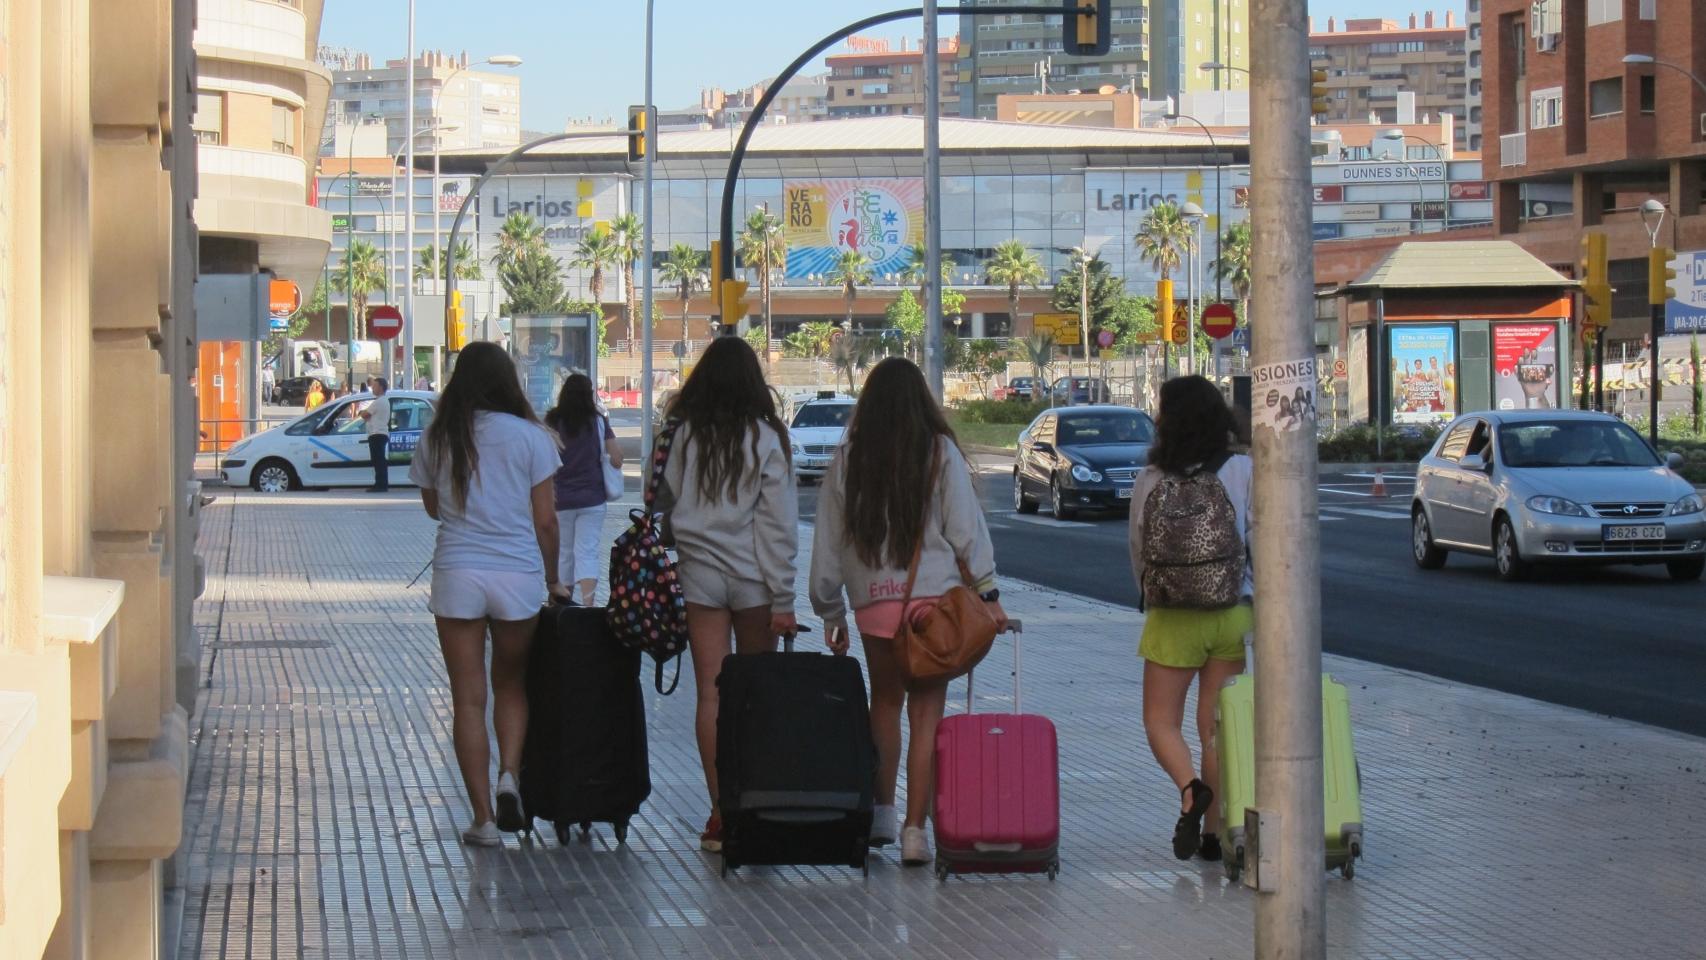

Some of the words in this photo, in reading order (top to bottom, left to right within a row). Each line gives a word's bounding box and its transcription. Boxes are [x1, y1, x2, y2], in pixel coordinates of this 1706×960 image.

[1343, 167, 1392, 179] DUNNES
[1395, 165, 1442, 178] STORES
[1096, 188, 1178, 211] Larios
[493, 195, 573, 218] Larios
[1674, 316, 1697, 329] MA-20
[1175, 330, 1187, 338] 30
[1643, 527, 1663, 538] CZC
